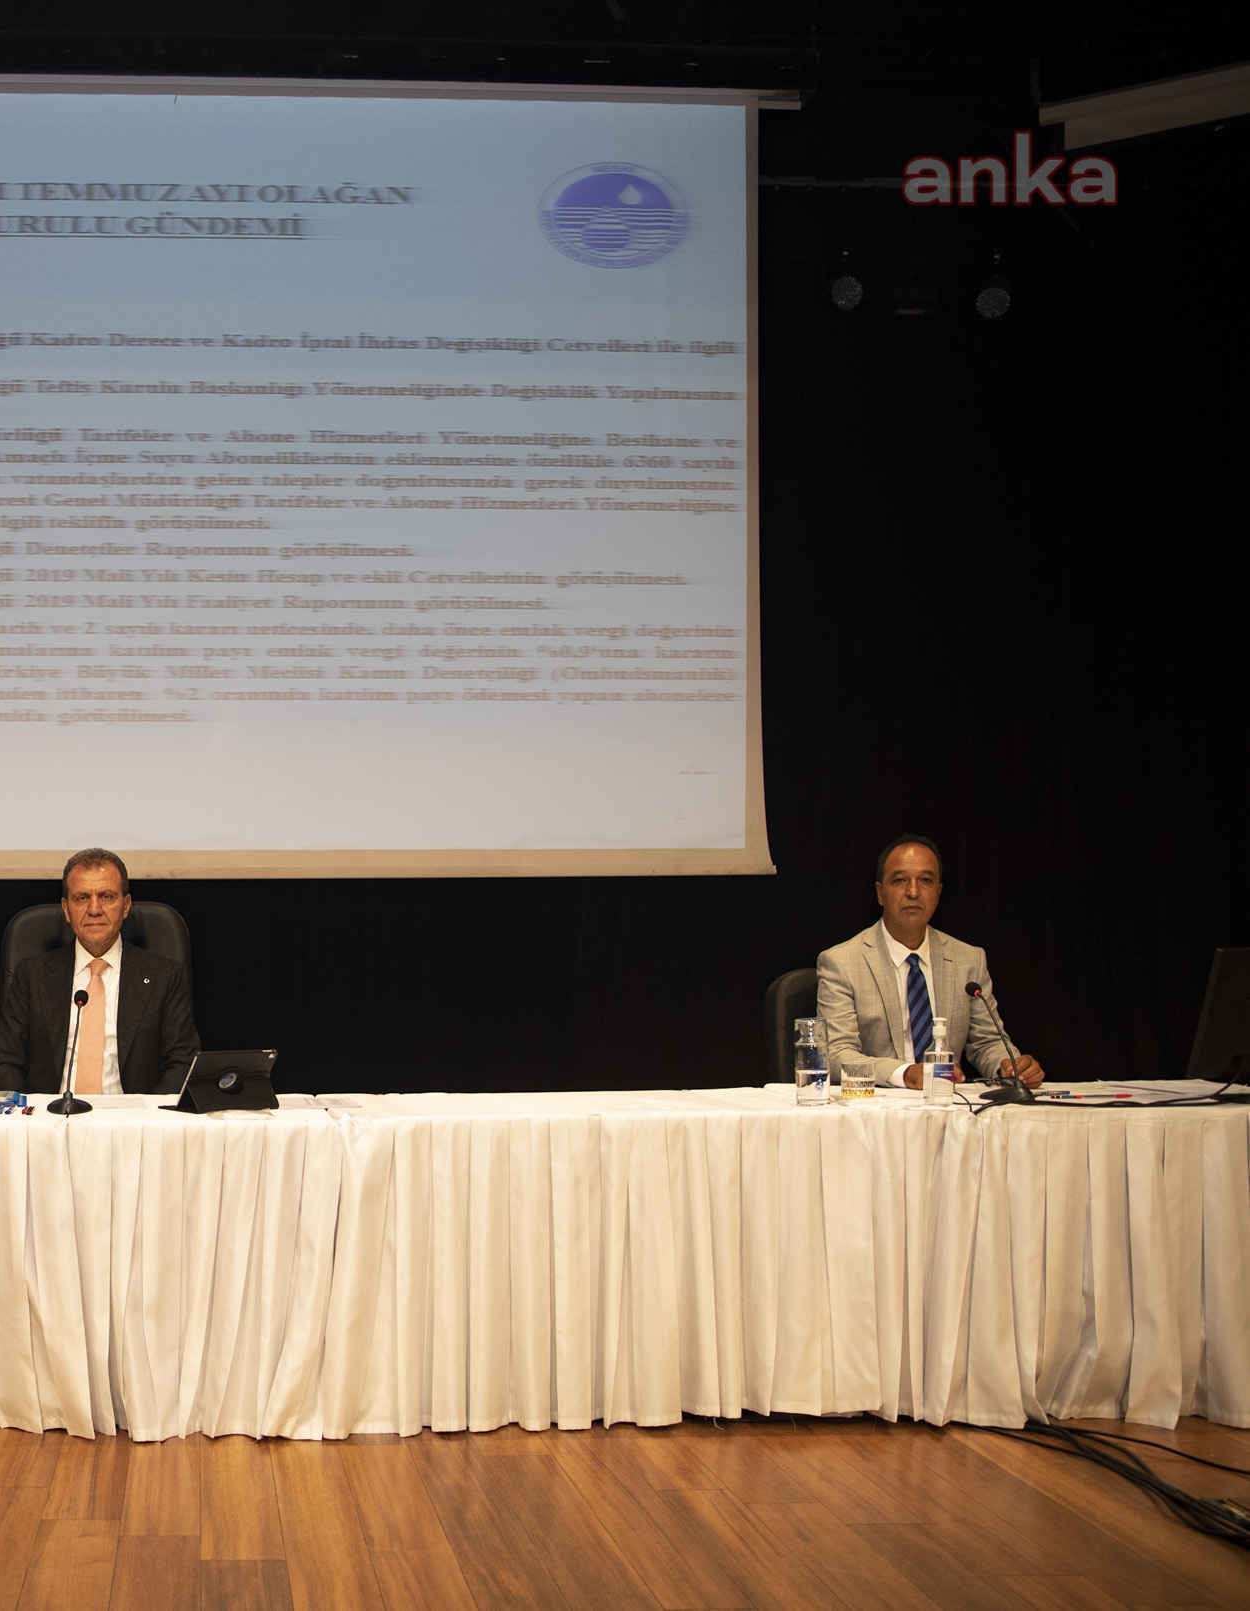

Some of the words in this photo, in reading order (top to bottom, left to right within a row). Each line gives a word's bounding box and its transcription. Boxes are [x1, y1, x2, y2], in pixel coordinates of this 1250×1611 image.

[16, 182, 183, 203] TEMMUZ
[188, 184, 250, 203] AYI
[257, 180, 411, 206] OLAĞAN
[125, 212, 306, 237] GÜNDEMİ
[29, 332, 101, 346] Kadro
[109, 333, 183, 346] Derece
[189, 337, 214, 347] ve
[222, 334, 293, 347] Kadro
[657, 339, 683, 353] ile
[186, 432, 211, 442] ve
[225, 429, 295, 443] Abone
[713, 438, 739, 448] ve
[622, 455, 670, 468] 6360
[44, 493, 106, 506] Genel
[351, 498, 375, 508] ve
[383, 495, 453, 509] Abone
[25, 569, 74, 582] 2019
[186, 569, 247, 583] Kesin
[257, 570, 323, 586] Hesap
[331, 573, 355, 583] ve
[24, 595, 74, 608] 2019
